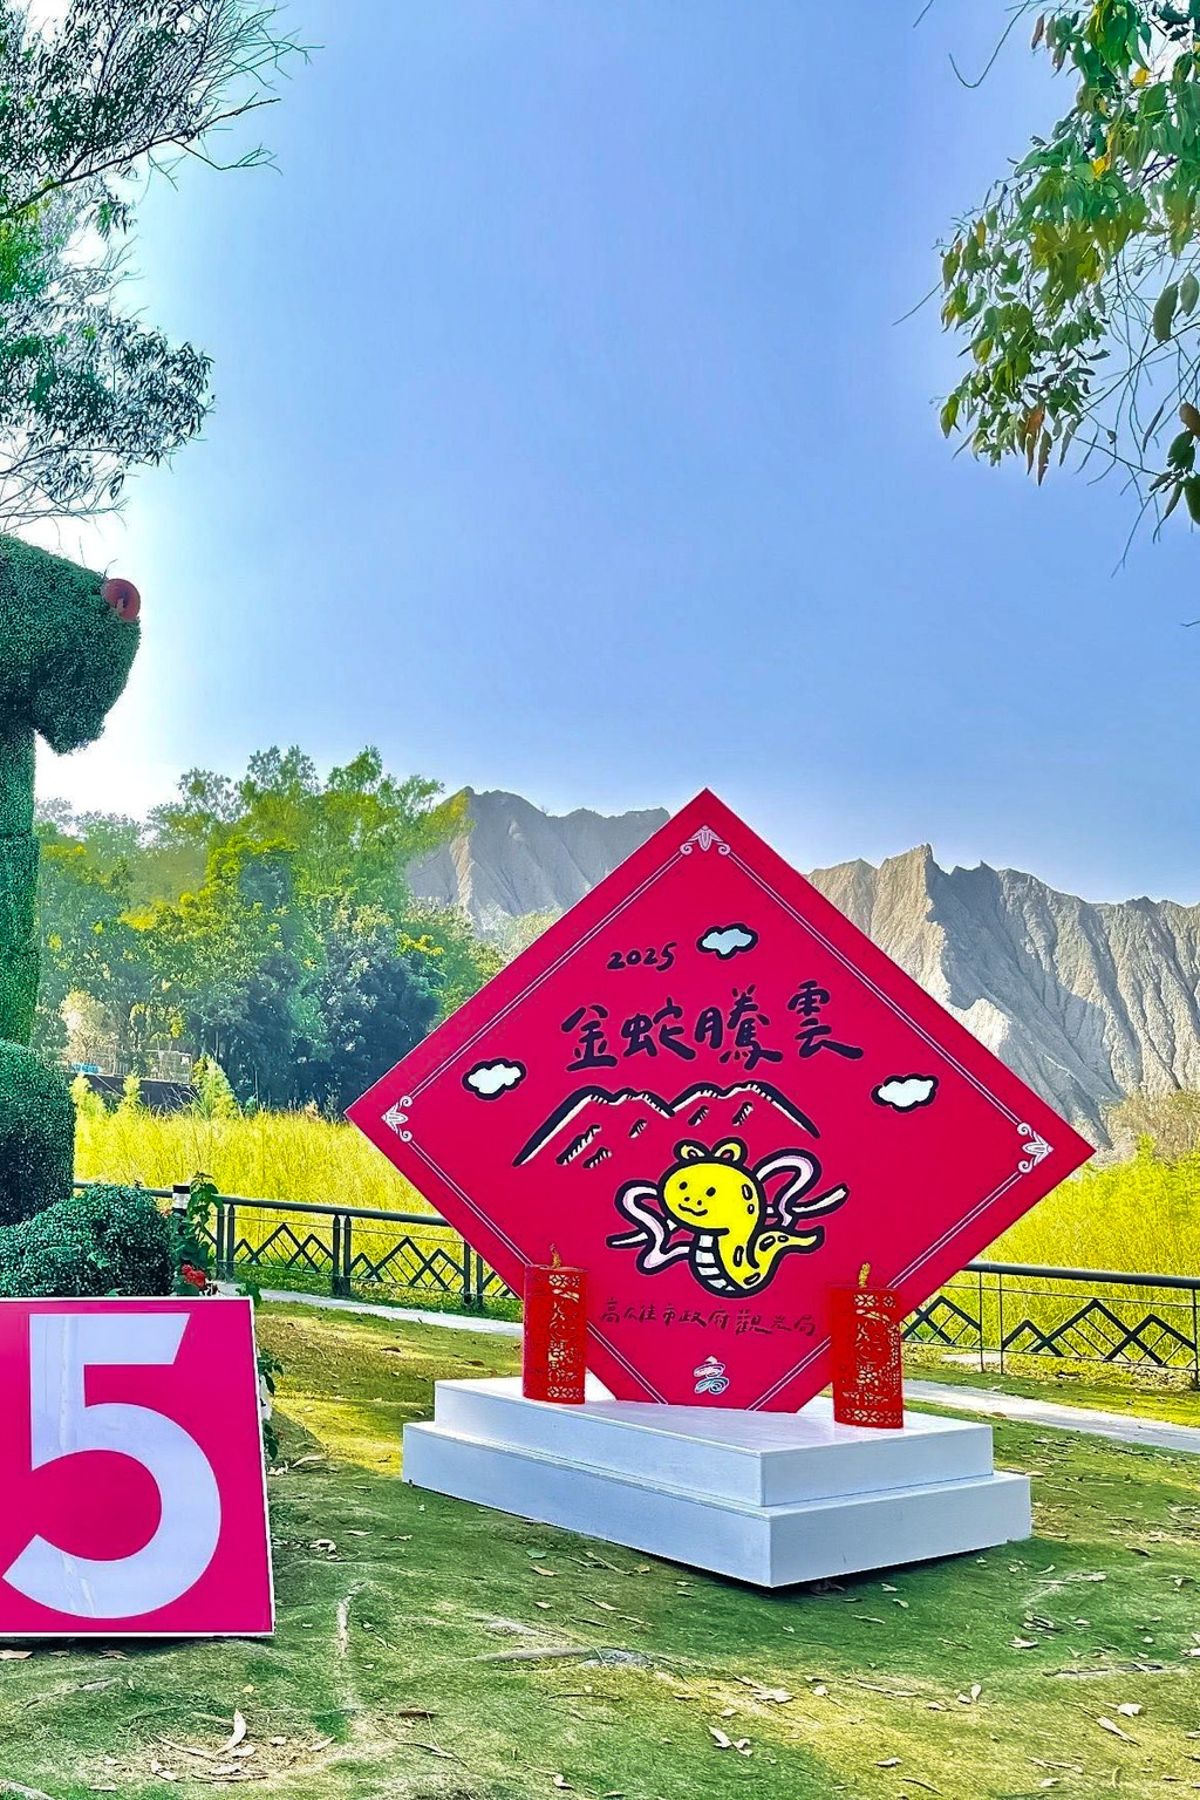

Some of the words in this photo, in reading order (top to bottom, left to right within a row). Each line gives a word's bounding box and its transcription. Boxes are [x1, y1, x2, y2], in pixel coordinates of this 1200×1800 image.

[607, 942, 677, 971] 2025
[561, 980, 864, 1072] 金蛇騰雲
